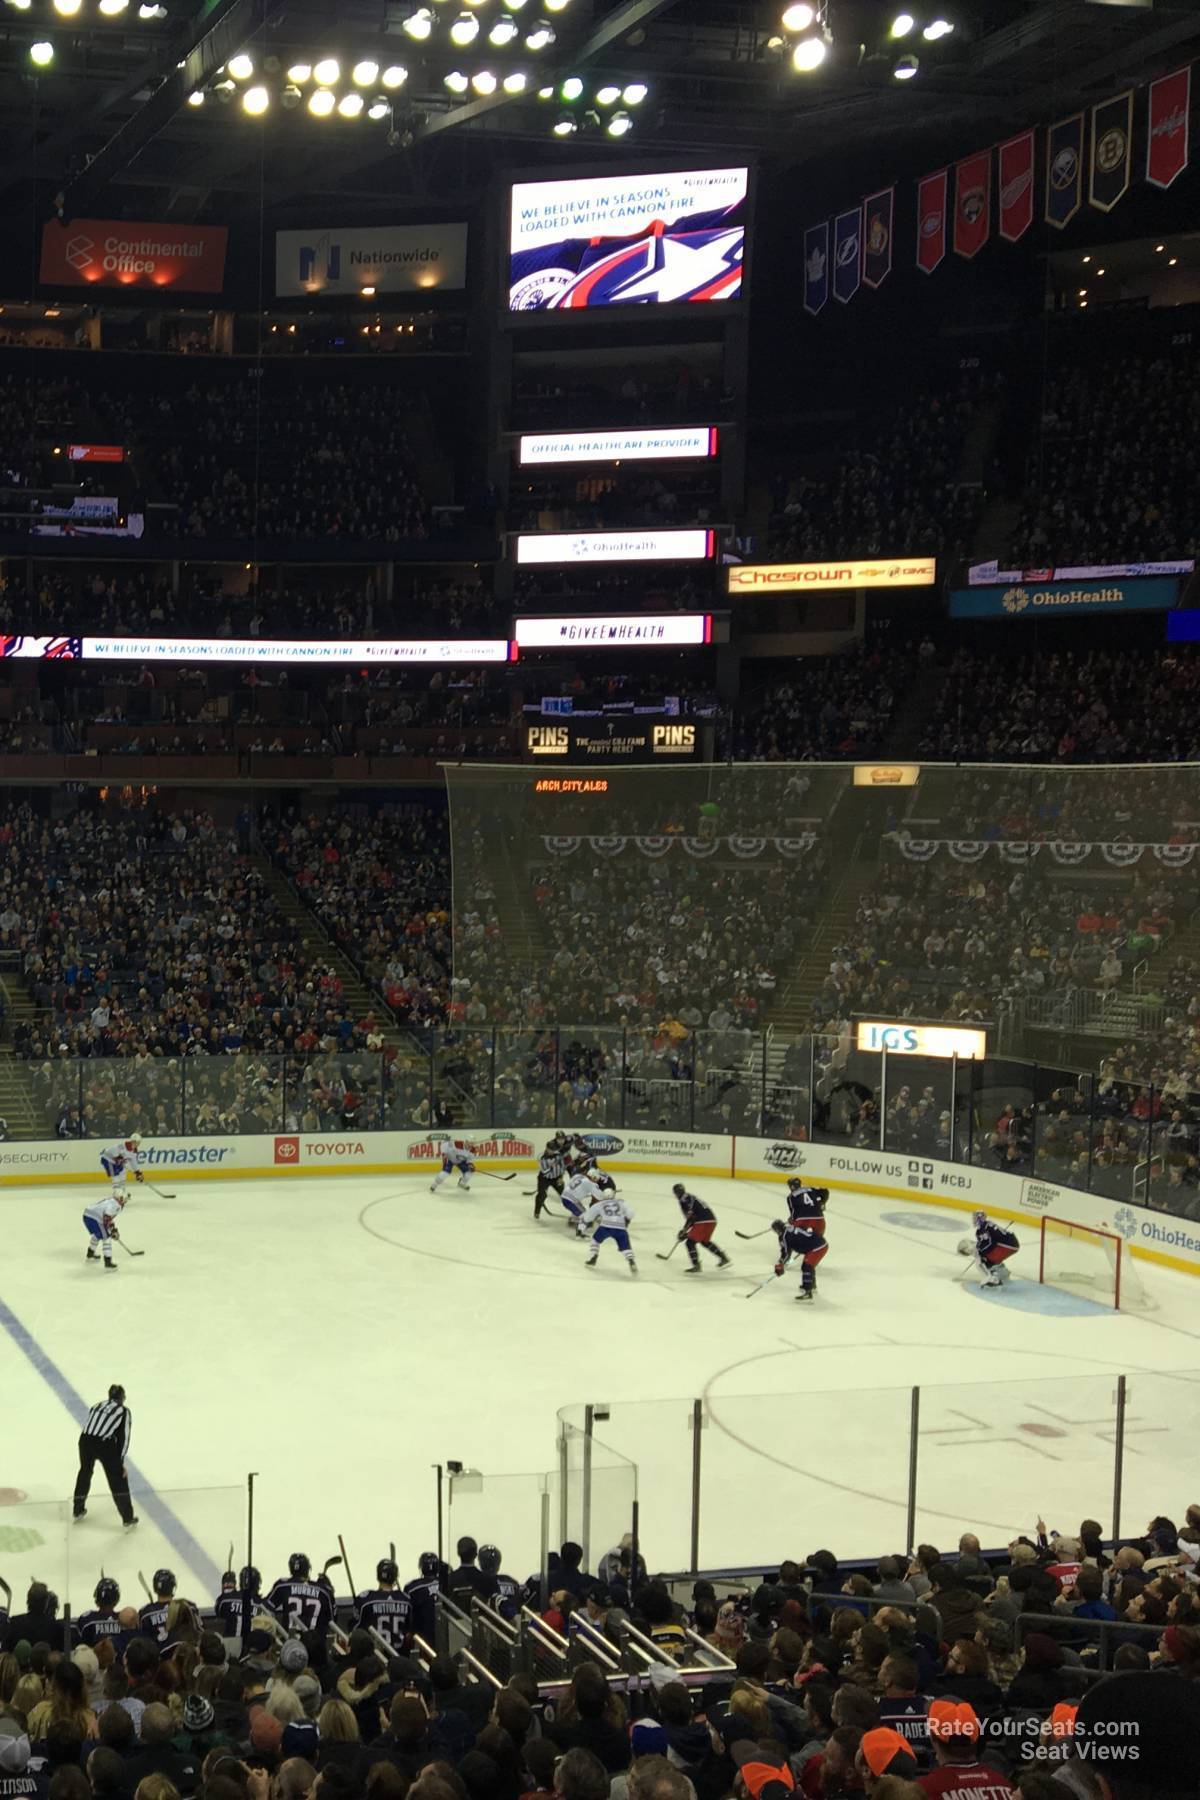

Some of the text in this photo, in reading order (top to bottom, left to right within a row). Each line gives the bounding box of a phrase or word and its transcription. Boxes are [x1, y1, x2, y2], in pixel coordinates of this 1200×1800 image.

[521, 187, 671, 219] WE BELIEVE IN SEASONS
[520, 197, 695, 233] LOADED WITH CANNON FIRE
[104, 237, 204, 257] Continental
[102, 254, 156, 273] Office
[350, 248, 440, 265] Nationwide
[531, 438, 701, 454] OFFICIAL HEALTHCARE PROVIDER
[730, 567, 934, 585] Chesrown GMC
[1032, 588, 1124, 606] OhioHealth
[95, 644, 354, 656] WE BELIEVE IN SEASONS LOADED WITH CANNON FIRE
[586, 746, 610, 754] PARTY
[65, 782, 85, 793] 116
[535, 780, 608, 793] ARCH CITY ALES
[871, 1027, 919, 1051] IGS
[306, 1143, 365, 1155] TOYOTA
[409, 1143, 434, 1157] PAPA
[627, 1138, 712, 1151] FEEL BETTER FAST
[3, 1152, 69, 1165] SECURITY
[830, 1157, 903, 1177] FOLLOW US
[940, 1173, 972, 1190] #CBJ
[1029, 1184, 1060, 1198] AMERICAN
[1027, 1195, 1049, 1208] POWER
[603, 1204, 621, 1218] 62
[290, 1585, 321, 1598] MURRAY
